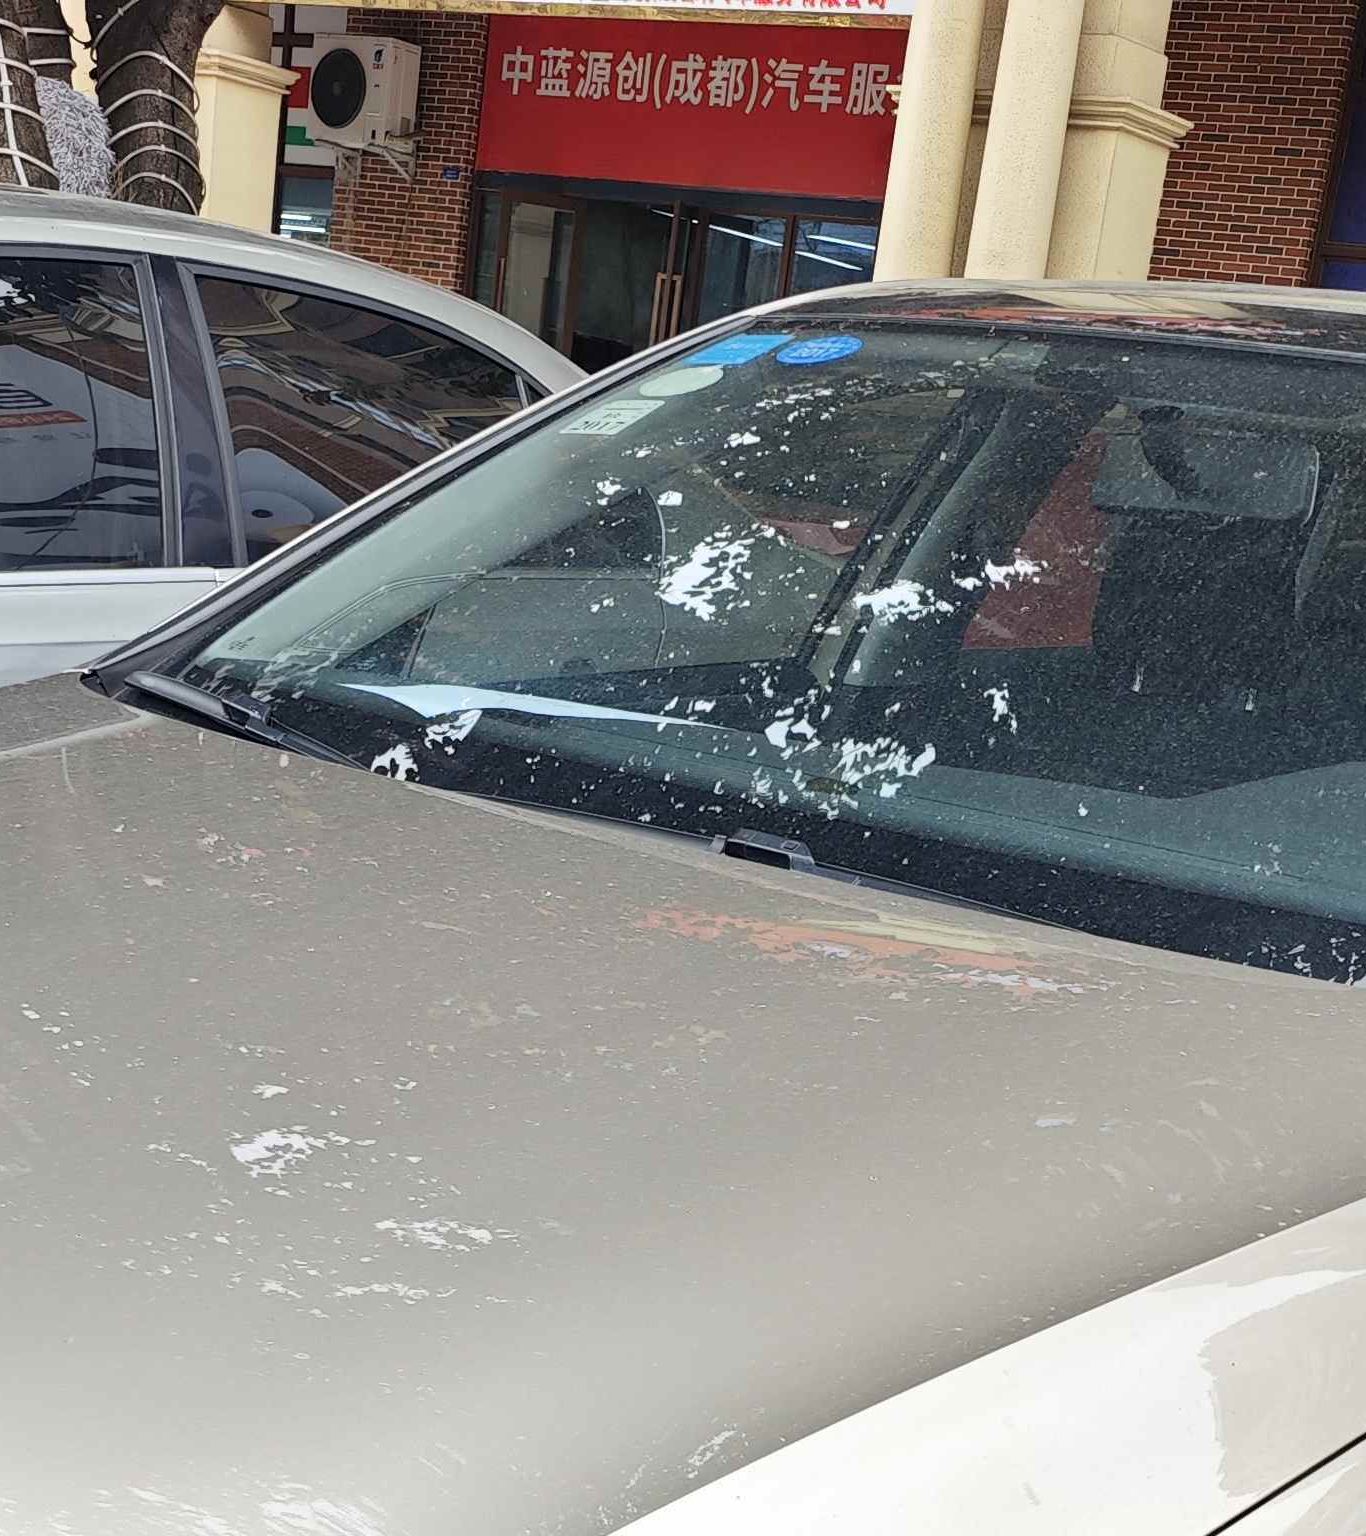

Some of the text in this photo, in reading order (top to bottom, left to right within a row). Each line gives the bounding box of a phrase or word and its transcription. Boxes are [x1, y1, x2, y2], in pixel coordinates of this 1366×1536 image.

[500, 46, 903, 116] 中蓝源创(成都)汽车服
